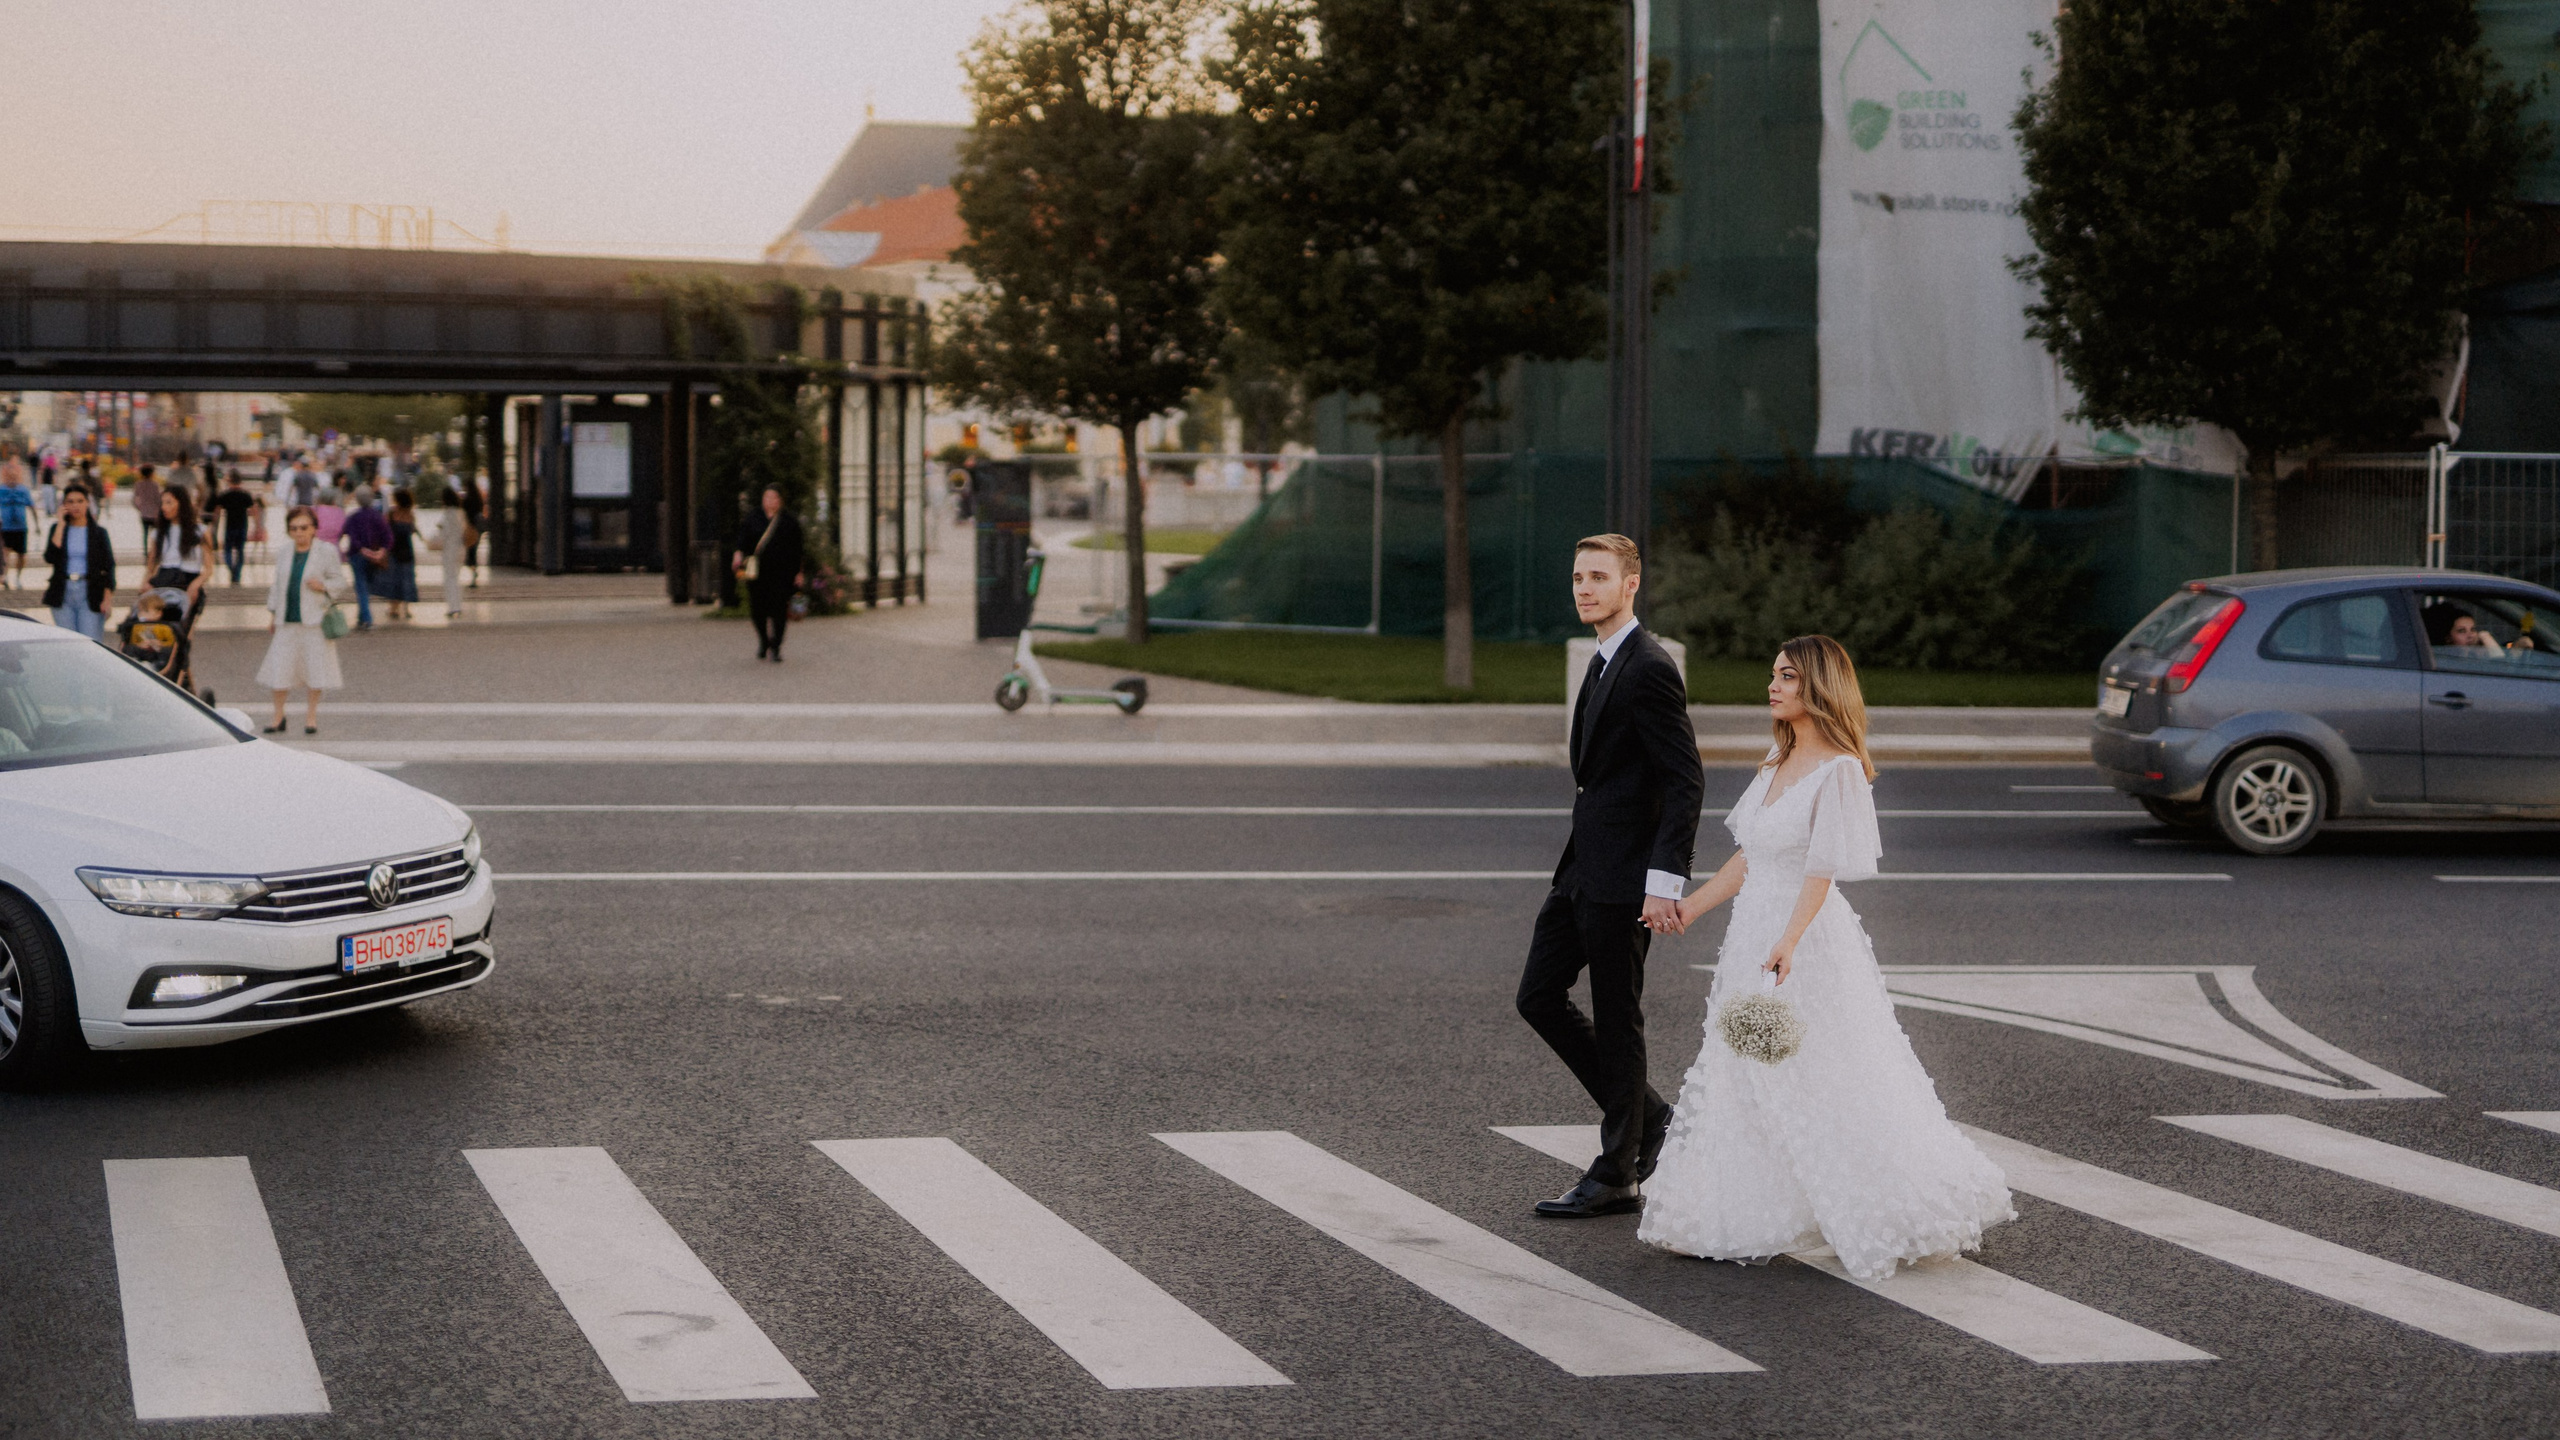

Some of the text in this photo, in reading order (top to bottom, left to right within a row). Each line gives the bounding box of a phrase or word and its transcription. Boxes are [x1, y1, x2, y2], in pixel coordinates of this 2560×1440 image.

[1898, 91, 1966, 109] GREEN
[1899, 113, 1981, 129] BUILDING
[1901, 132, 2000, 150] SOLUTIONS
[356, 924, 447, 965] BH038745
